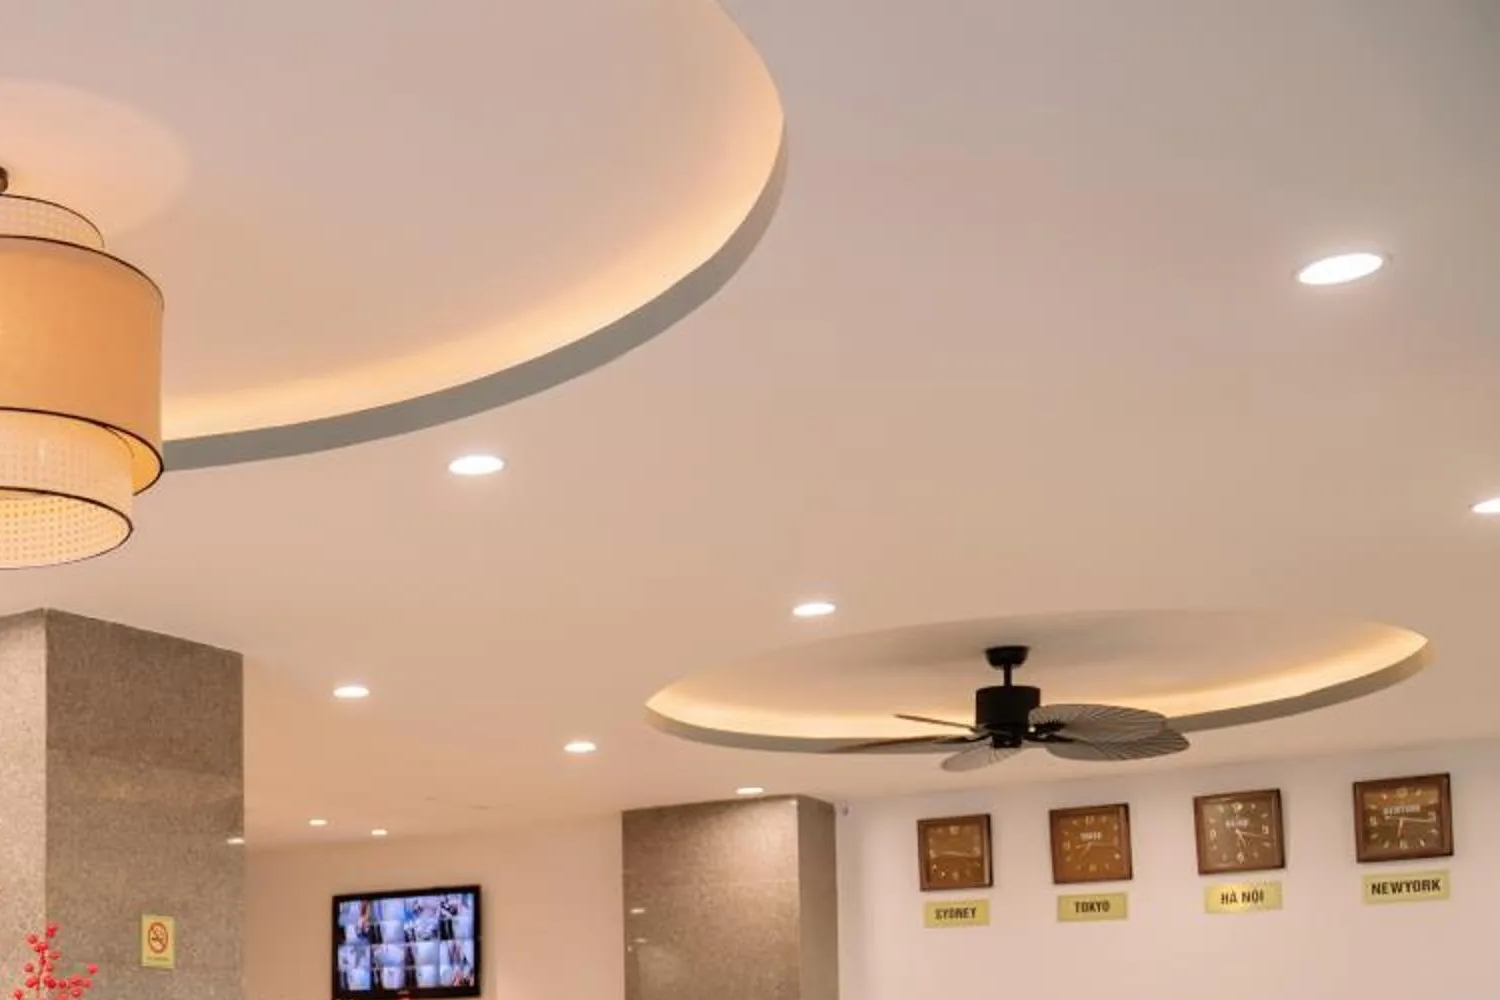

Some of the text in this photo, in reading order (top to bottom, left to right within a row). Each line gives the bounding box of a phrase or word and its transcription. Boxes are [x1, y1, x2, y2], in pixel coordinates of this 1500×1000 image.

[1370, 878, 1442, 895] NEWYORK
[934, 907, 977, 920] SYDNEY
[1075, 900, 1111, 914] TOKYO
